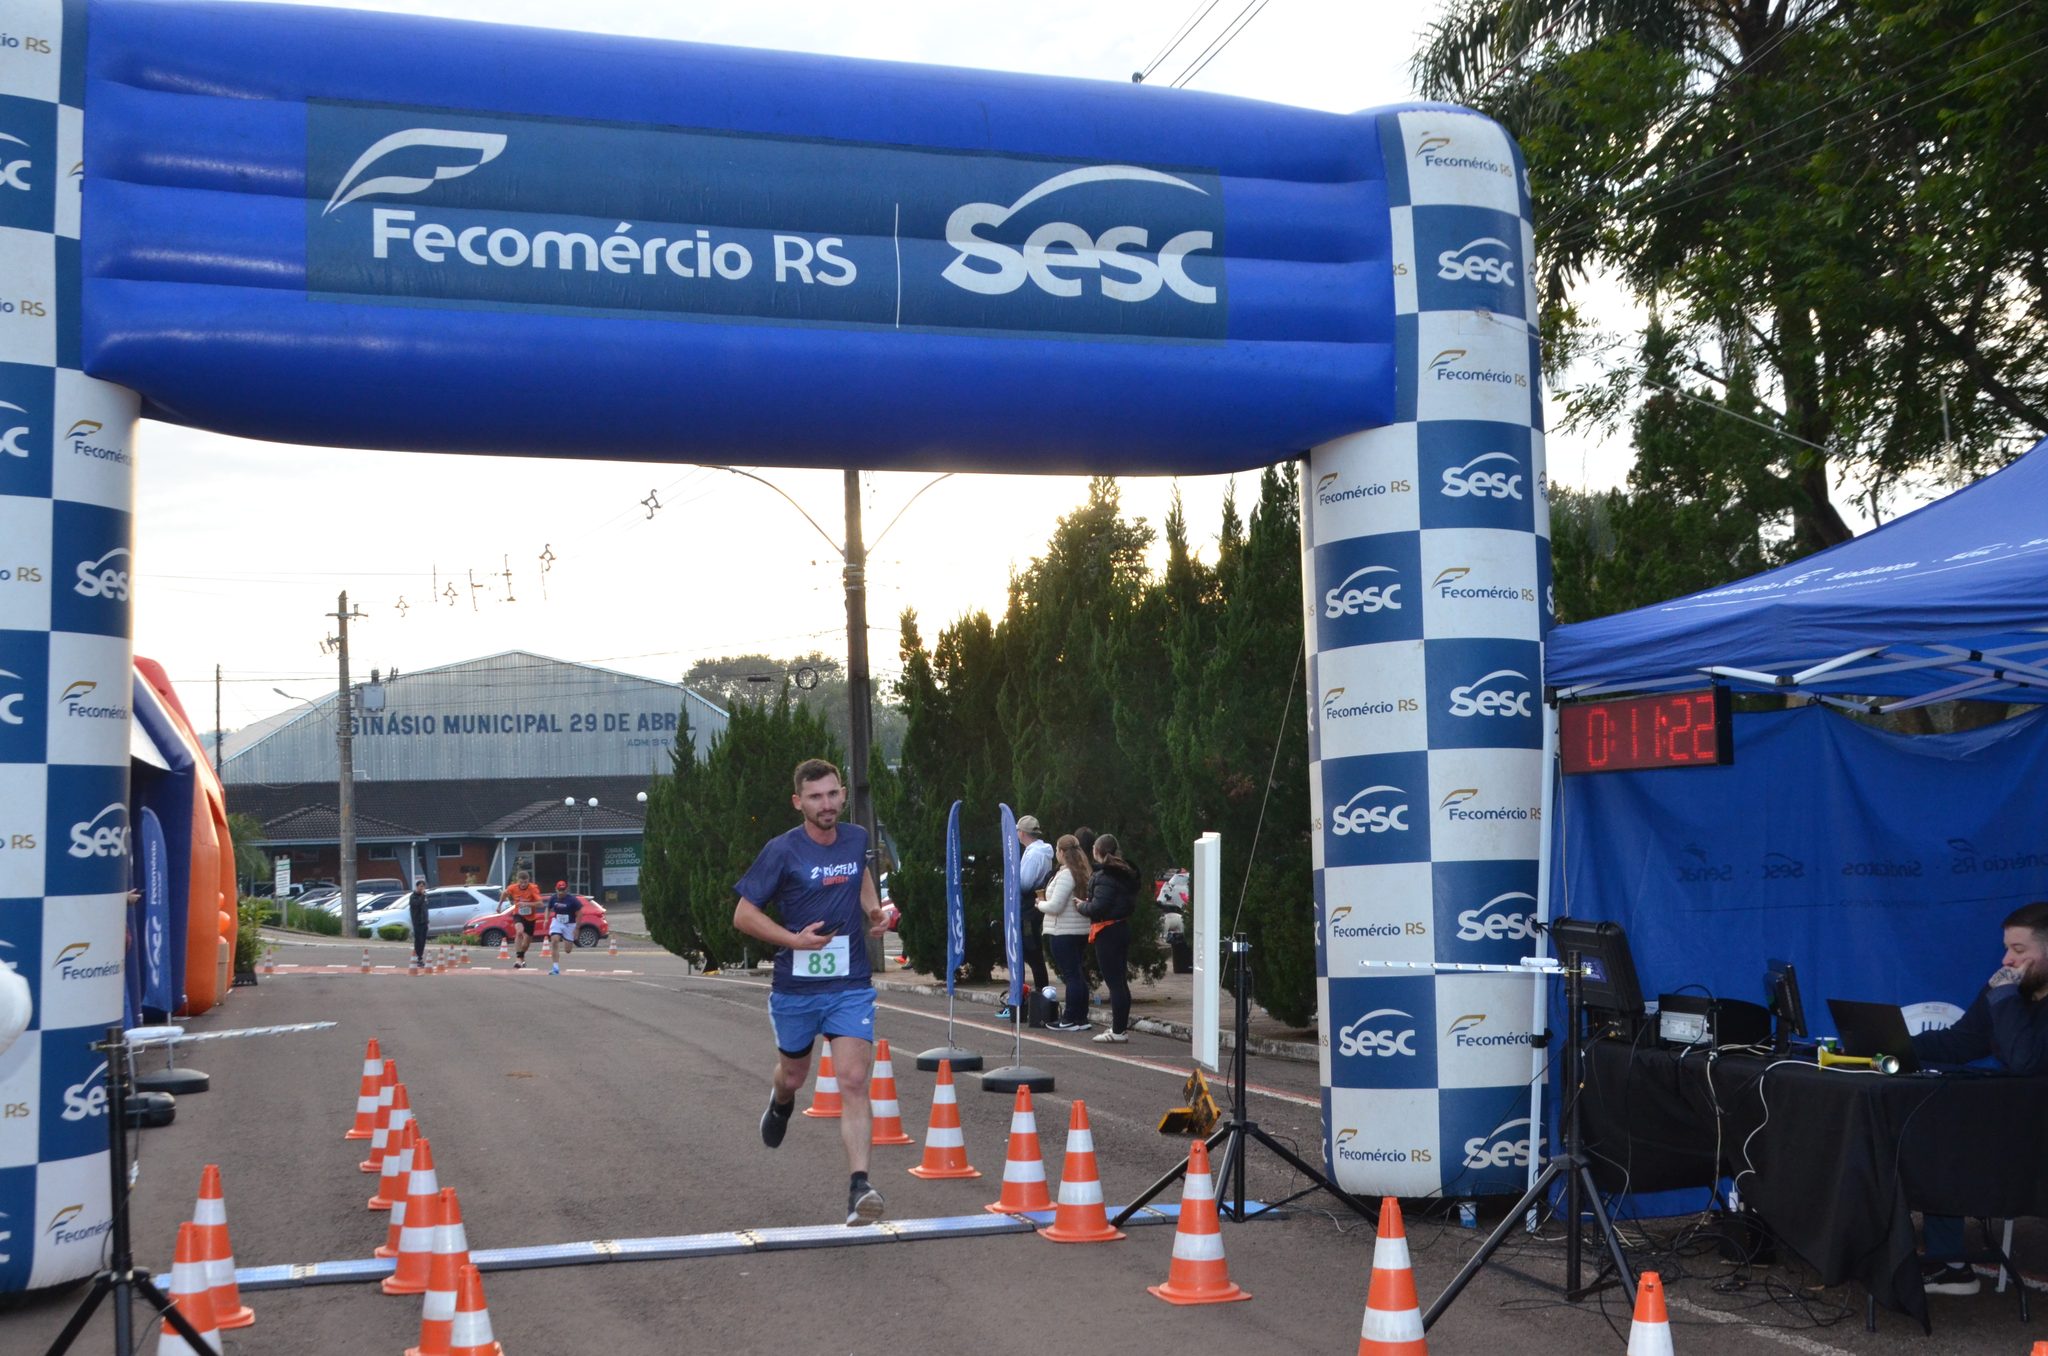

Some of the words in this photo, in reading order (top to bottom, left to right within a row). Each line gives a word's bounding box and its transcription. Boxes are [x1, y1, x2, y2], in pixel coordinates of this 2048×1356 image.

[25, 36, 51, 54] RS
[1424, 155, 1498, 173] Fecomércio
[1500, 163, 1513, 177] RS
[372, 208, 753, 281] Fecomércio
[774, 233, 857, 287] RS
[941, 196, 1218, 304] Sesc
[21, 300, 46, 317] RS
[1437, 368, 1512, 384] Fecomércio
[1514, 373, 1527, 388] RS
[1319, 483, 1386, 505] Fecomércio
[1391, 480, 1411, 493] RS
[17, 567, 42, 584] RS
[73, 559, 130, 602] Ses
[1441, 585, 1519, 601] Fecomércio
[1522, 587, 1534, 602] RS
[1326, 700, 1393, 719] Fecomércio
[1398, 699, 1418, 713] RS
[351, 711, 435, 735] GINÁSIO
[443, 713, 562, 735] MUNICIPAL
[570, 713, 597, 733] 29
[604, 713, 630, 732] DE
[637, 712, 697, 732] ABR
[1449, 806, 1528, 820] Fecomércio
[1333, 922, 1401, 938] Fecomércio
[1405, 921, 1426, 935] RS
[808, 952, 836, 975] 83
[5, 1102, 30, 1118] RS
[61, 1083, 109, 1121] Se
[1339, 1147, 1407, 1163] Fecomércio
[1411, 1149, 1432, 1163] RS
